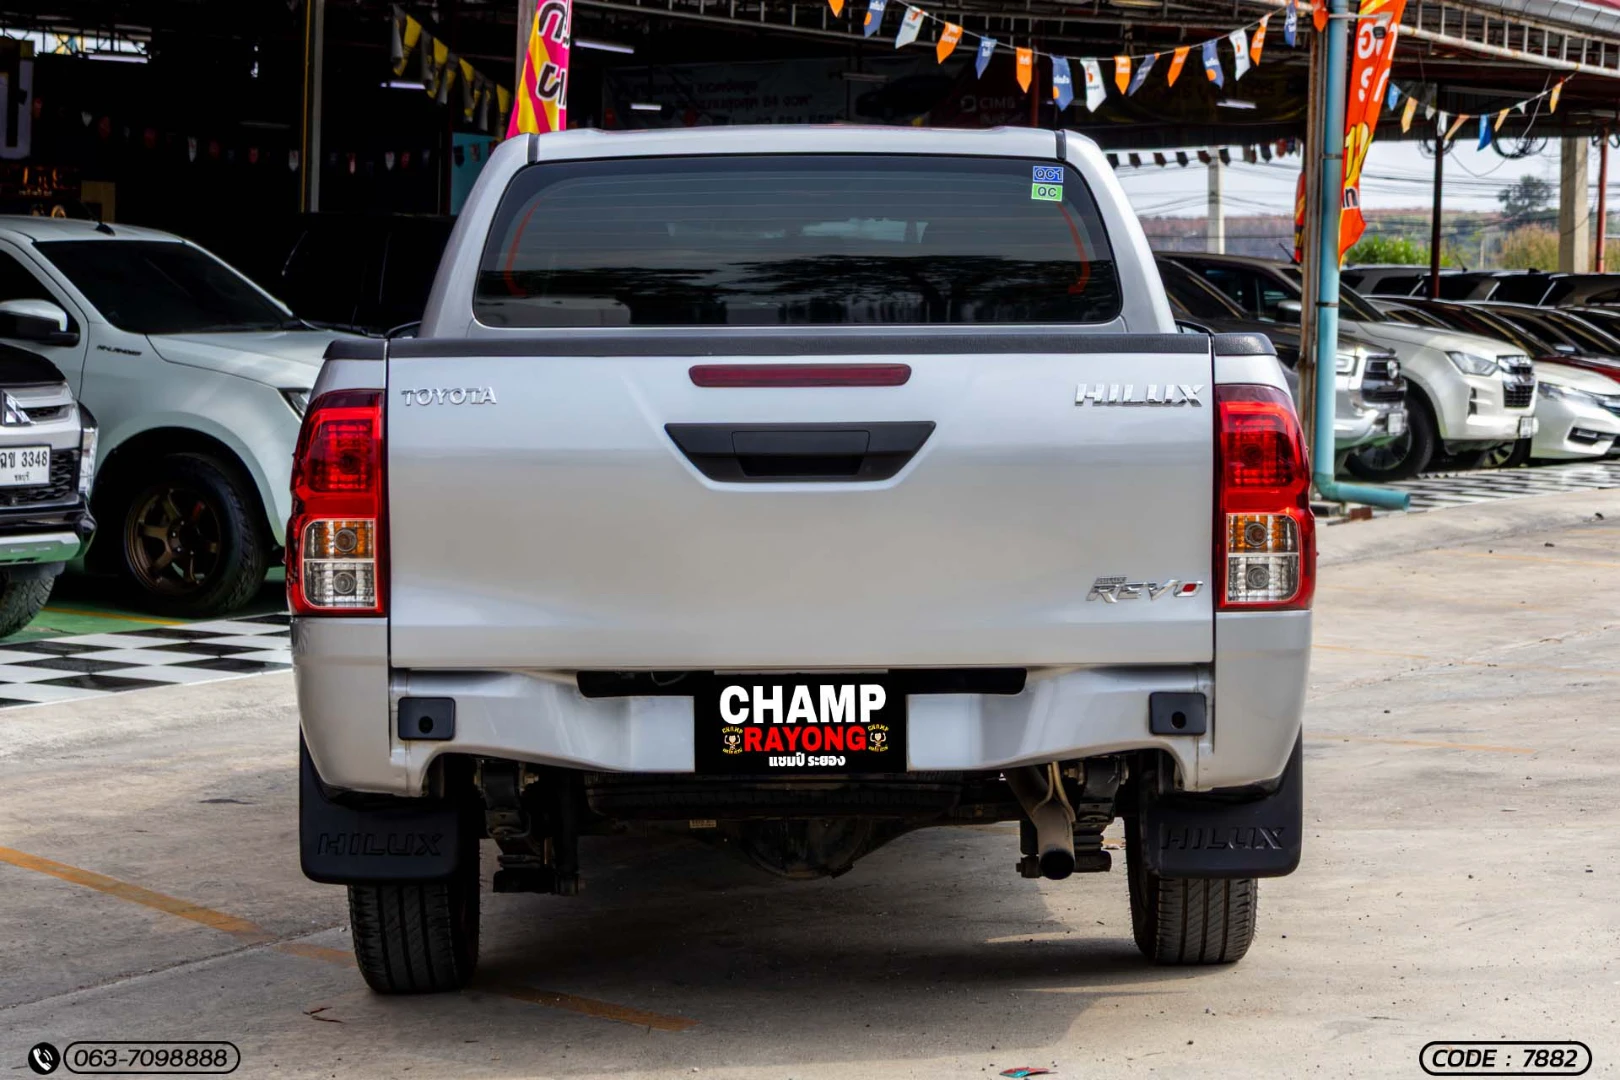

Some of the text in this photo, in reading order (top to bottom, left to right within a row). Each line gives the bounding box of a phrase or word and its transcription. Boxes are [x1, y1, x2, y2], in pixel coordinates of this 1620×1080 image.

[1035, 169, 1062, 179] QC1
[1038, 187, 1057, 197] QC
[401, 386, 497, 406] TOYOTA
[1075, 384, 1204, 407] HILUX
[21, 450, 48, 468] 3348
[1086, 579, 1204, 603] REVO
[317, 833, 444, 856] HILUX
[1161, 827, 1286, 850] HILUX
